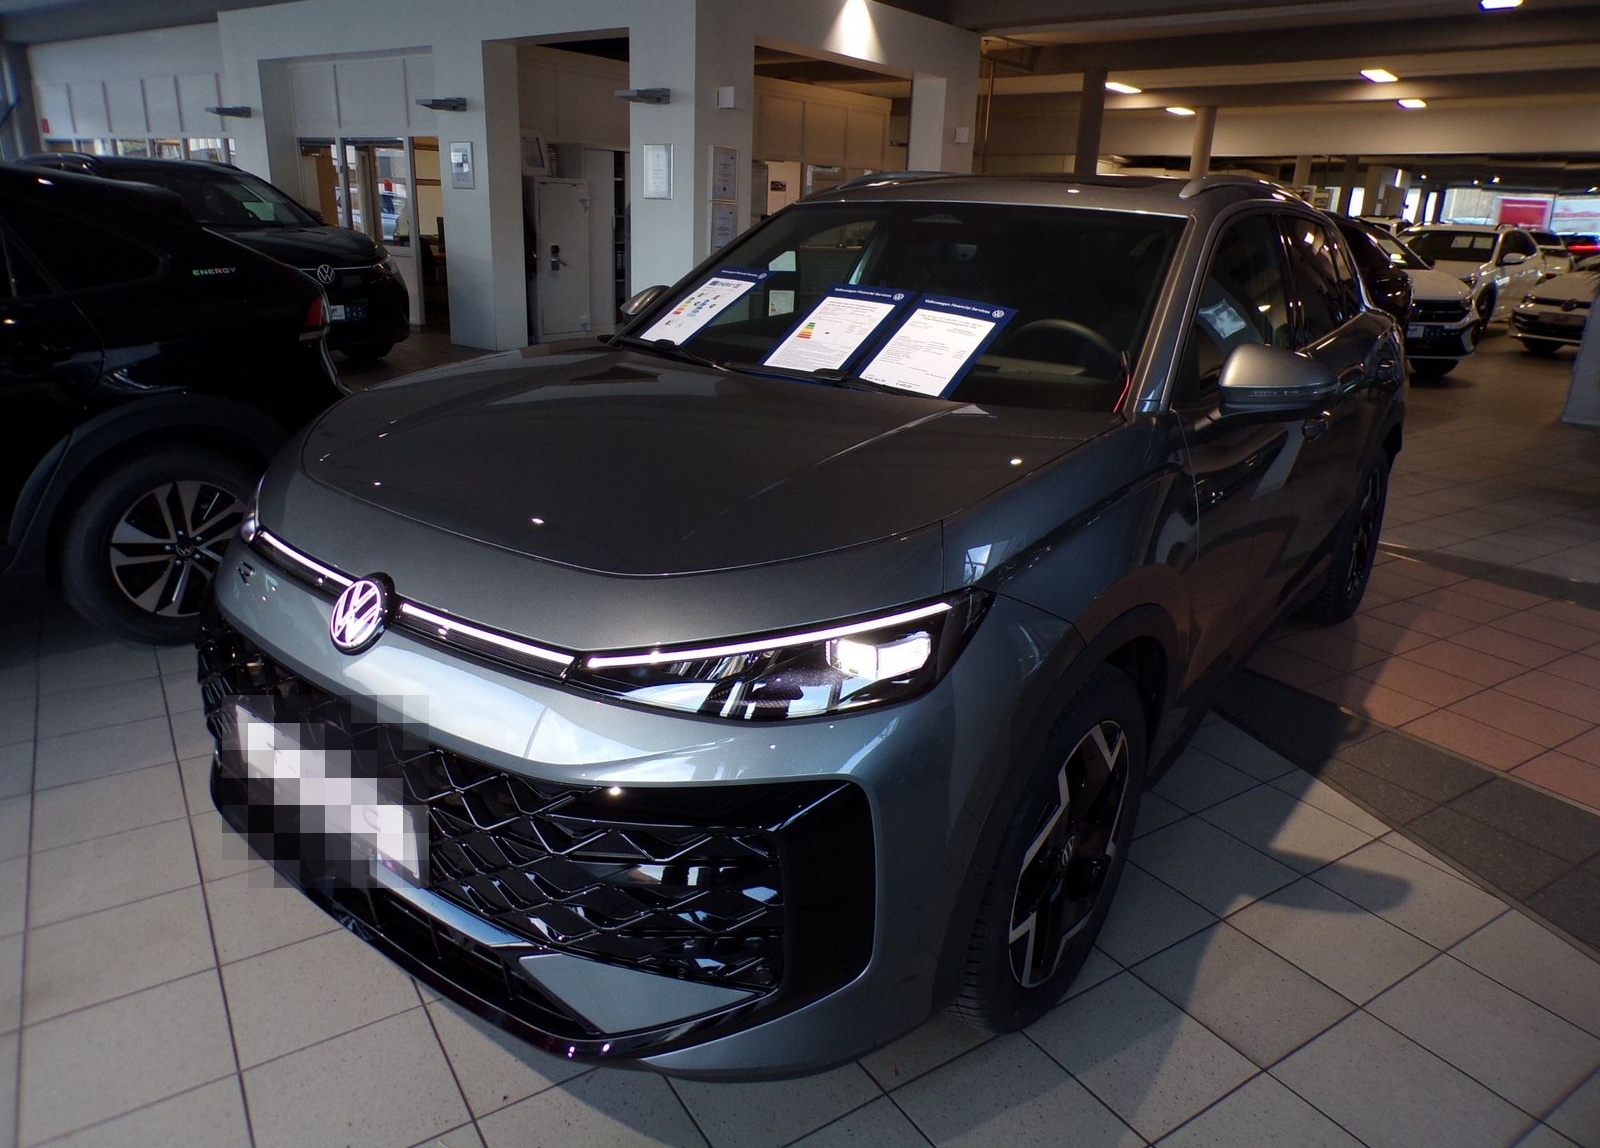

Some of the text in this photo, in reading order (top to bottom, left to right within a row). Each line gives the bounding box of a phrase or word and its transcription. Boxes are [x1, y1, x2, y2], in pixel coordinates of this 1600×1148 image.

[192, 267, 236, 276] ENERGY
[924, 299, 950, 307] Volkswagen
[971, 306, 991, 314] Services
